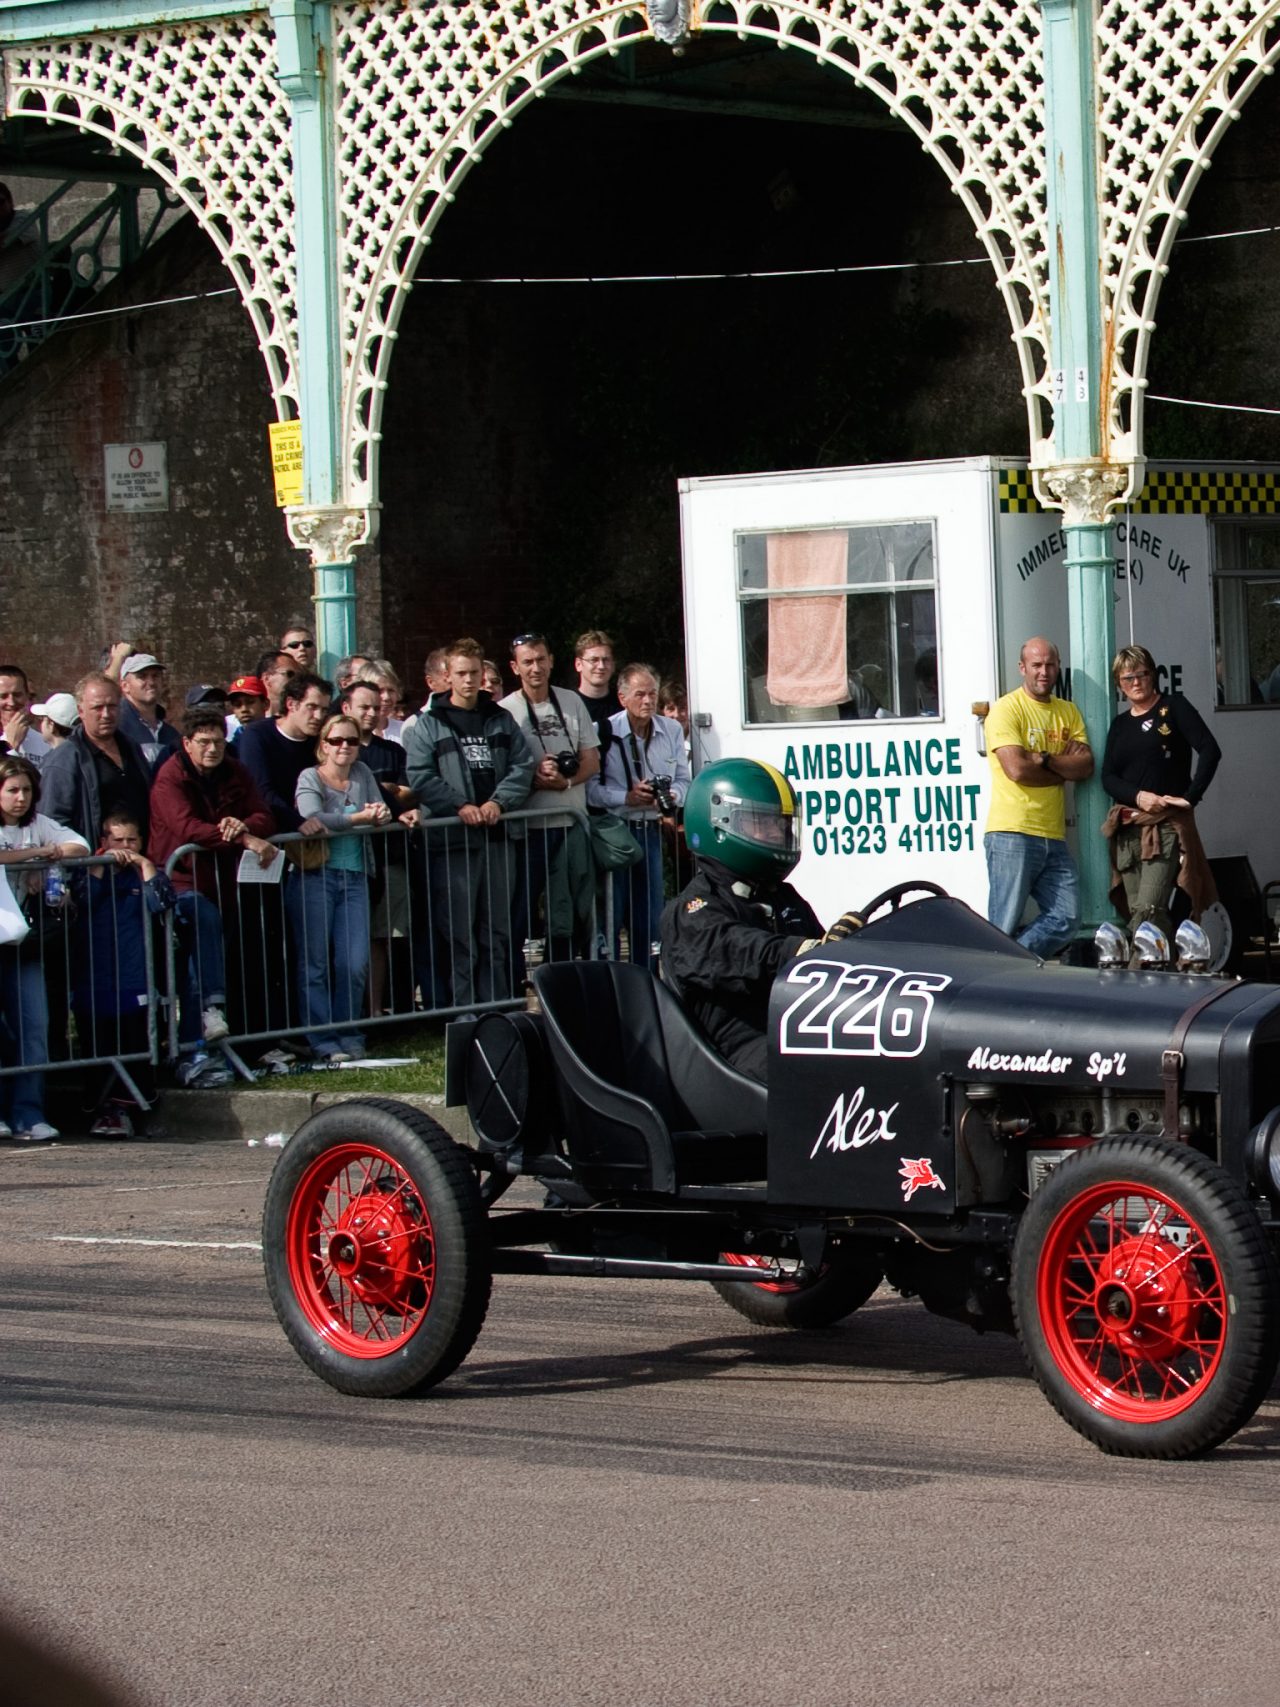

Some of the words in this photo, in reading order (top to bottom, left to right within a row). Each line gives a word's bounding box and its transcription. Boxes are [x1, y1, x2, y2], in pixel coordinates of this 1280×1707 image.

[274, 454, 284, 463] CAR
[276, 442, 287, 451] THIS
[288, 441, 295, 449] IS
[296, 440, 301, 448] A
[274, 464, 290, 473] PATROL
[292, 461, 303, 470] ARE
[1116, 521, 1162, 558] CARE
[1167, 549, 1191, 583] UK
[1112, 558, 1144, 585] EX)
[784, 738, 962, 780] AMBULANCE
[797, 787, 901, 826] PPORT
[914, 784, 981, 823] UNIT
[813, 824, 887, 856] 01323
[898, 822, 974, 853] 411191
[779, 958, 952, 1058] 226
[967, 1046, 1072, 1074] Alexander
[1086, 1051, 1126, 1082] Sp'l
[810, 1086, 900, 1160] Alex
